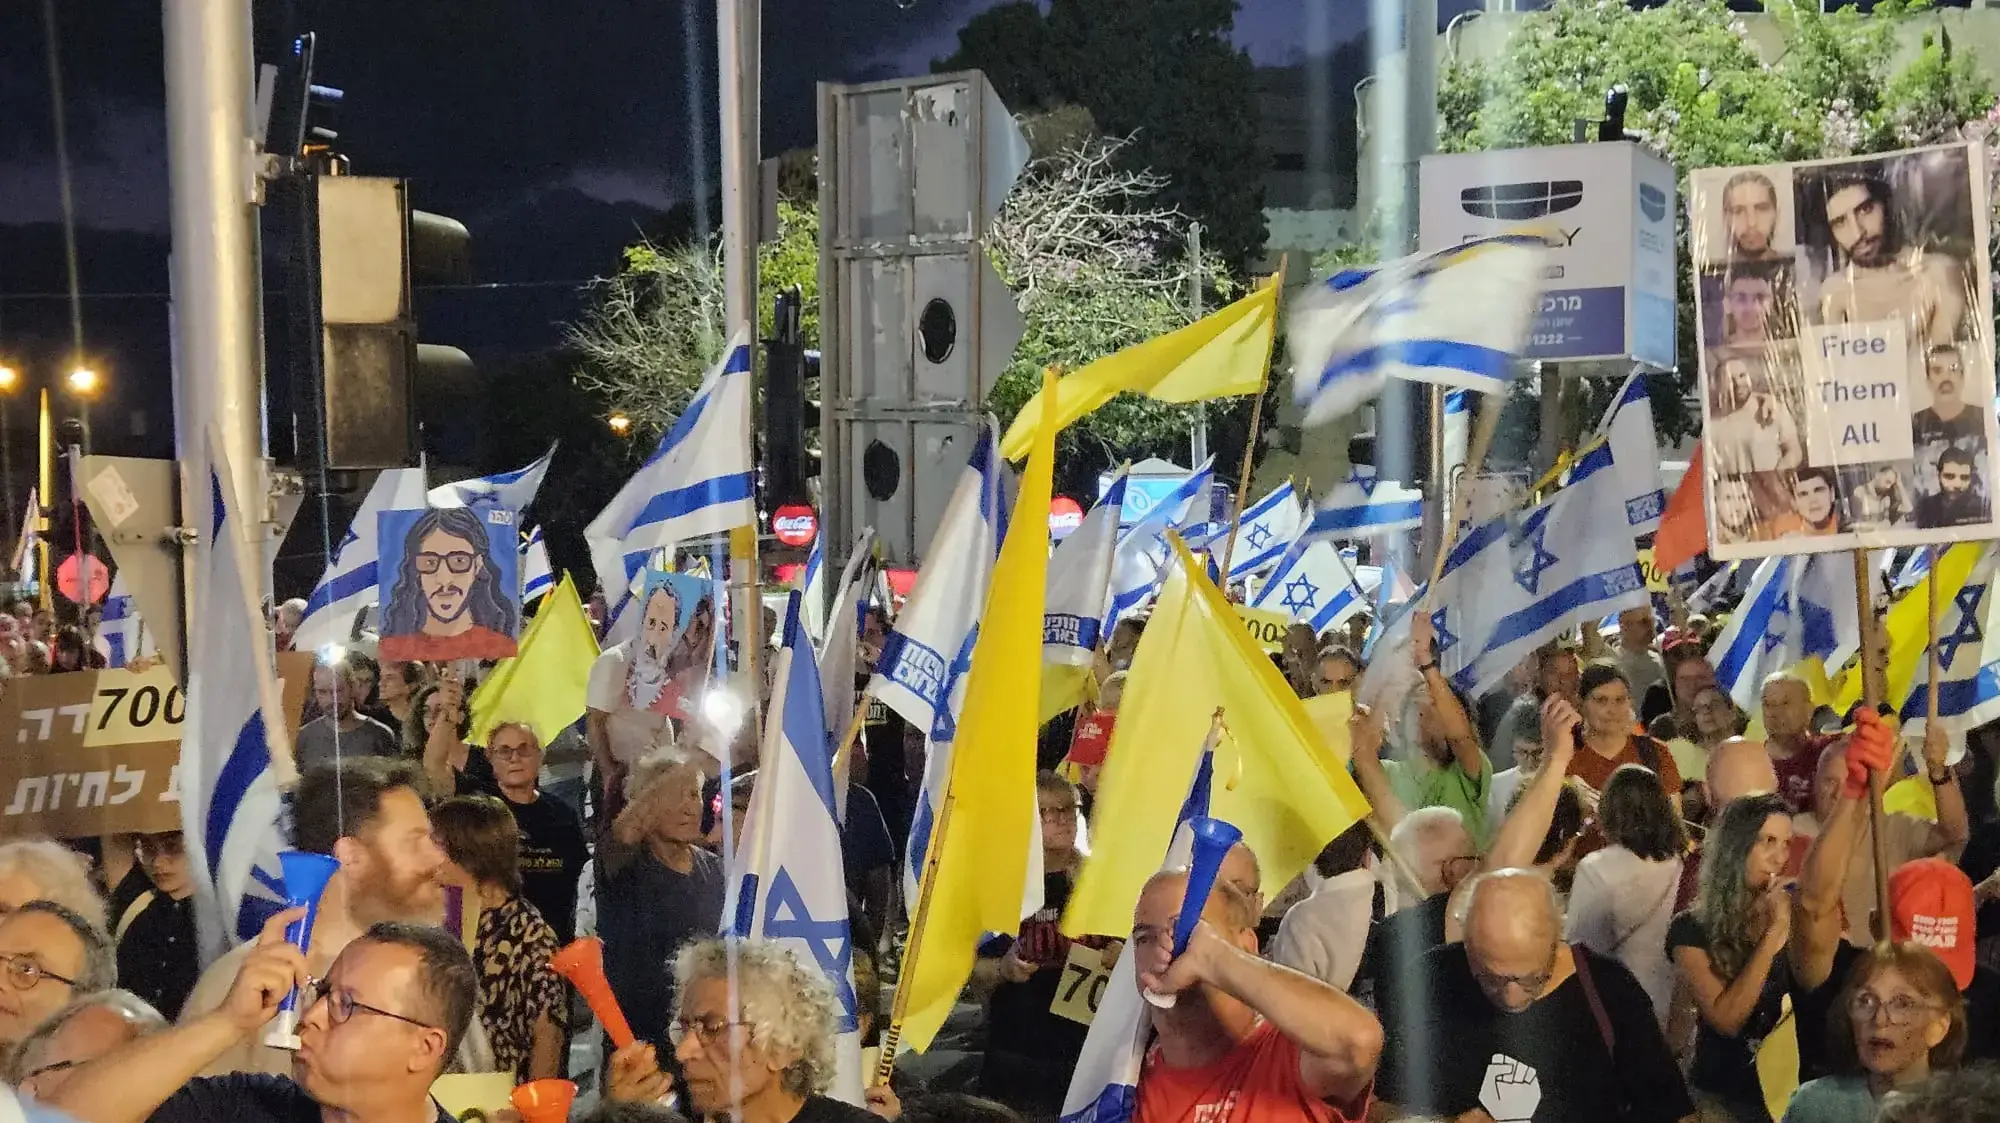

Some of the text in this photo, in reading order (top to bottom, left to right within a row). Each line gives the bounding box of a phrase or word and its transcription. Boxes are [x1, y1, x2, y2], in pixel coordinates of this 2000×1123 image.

[1822, 335, 1886, 359] Free
[1816, 379, 1897, 402] Them
[1841, 421, 1881, 447] All
[17, 703, 92, 743] דה
[97, 685, 187, 730] 700
[4, 764, 146, 815] לחיות
[1062, 962, 1110, 1014] 70
